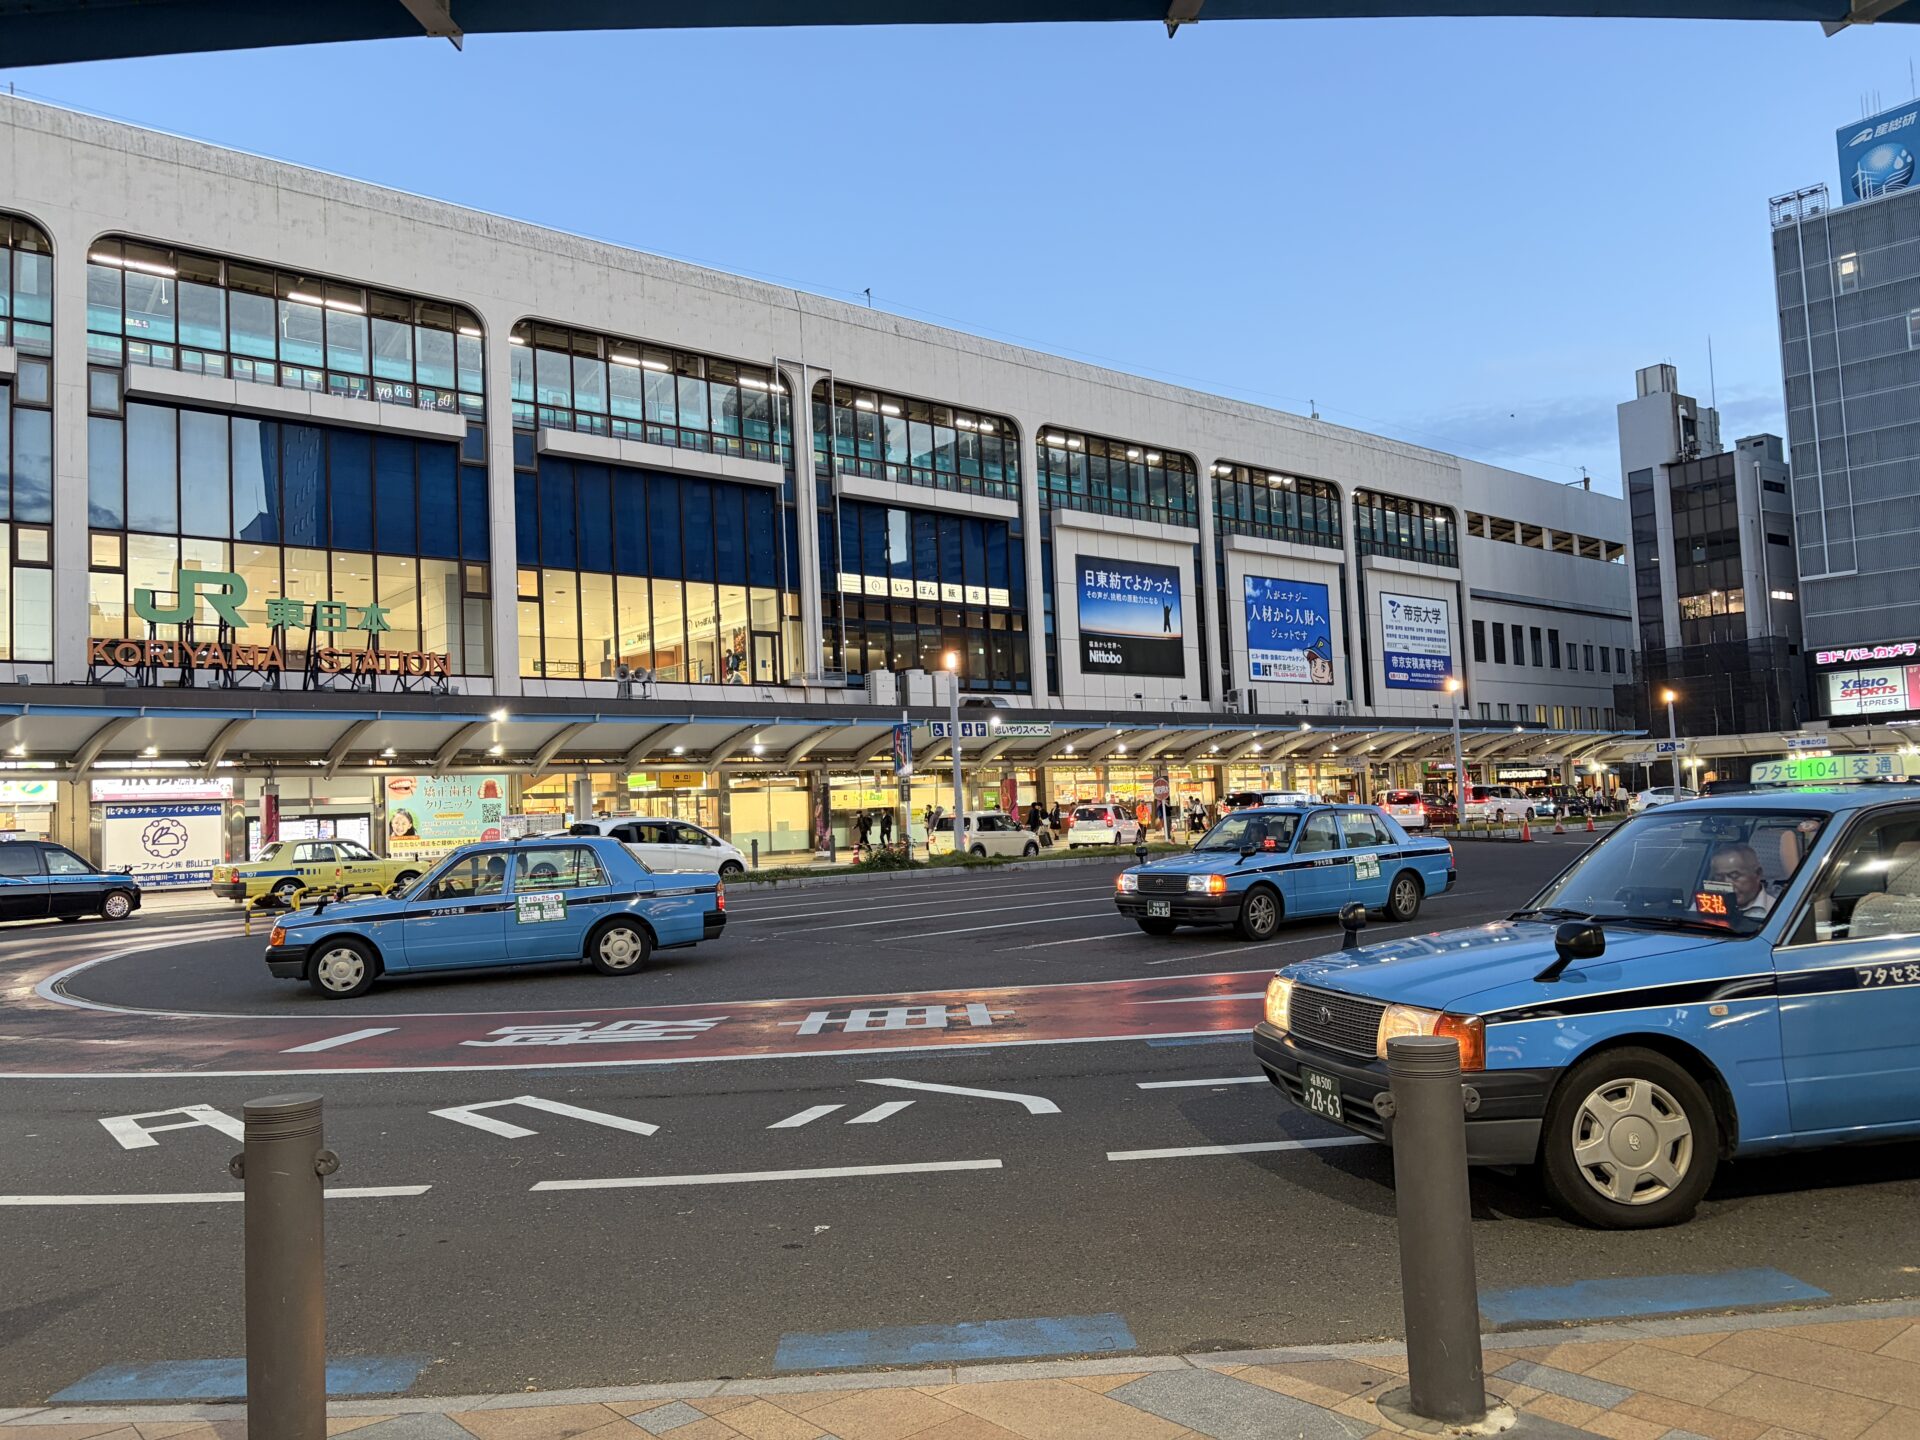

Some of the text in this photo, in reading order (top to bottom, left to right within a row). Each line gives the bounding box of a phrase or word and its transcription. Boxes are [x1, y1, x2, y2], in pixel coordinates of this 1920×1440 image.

[1874, 112, 1918, 138] 産総研
[1085, 569, 1173, 595] 日東紡でよかった
[134, 569, 391, 635] JR 東日本
[1265, 588, 1309, 602] 人がエナジー
[1250, 603, 1326, 626] 人材から人財へ
[1403, 605, 1441, 624] 帝京大学
[1271, 628, 1308, 641] ジェットです
[1088, 649, 1123, 664] Nittobo
[1817, 642, 1917, 664] ヨドバシカメラ
[317, 646, 453, 677] STATION
[1262, 665, 1272, 678] JET
[1840, 677, 1889, 690] XEBIO
[1840, 684, 1898, 698] SPORTS
[1856, 697, 1900, 708] EXPRESS
[1658, 742, 1666, 752] P
[1498, 769, 1548, 780] McDonald's
[1756, 756, 1893, 780] フタセ 104 交通
[106, 806, 157, 816] 化学をカタチに
[425, 799, 473, 811] クリニック
[1696, 893, 1727, 915] 支払
